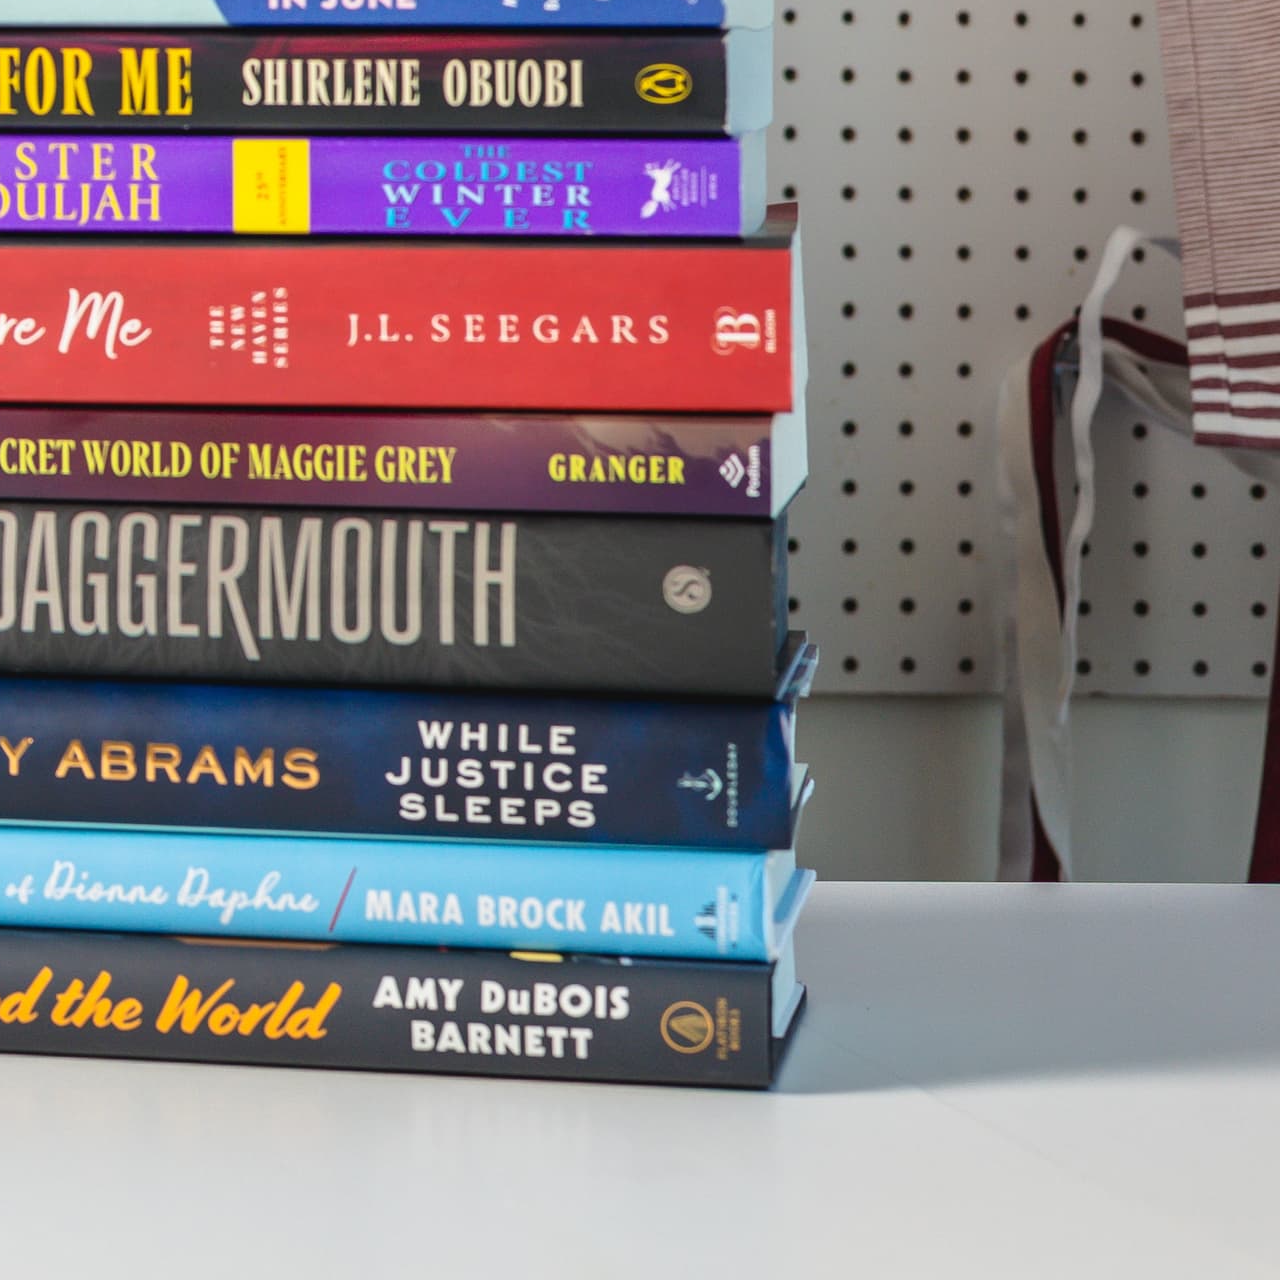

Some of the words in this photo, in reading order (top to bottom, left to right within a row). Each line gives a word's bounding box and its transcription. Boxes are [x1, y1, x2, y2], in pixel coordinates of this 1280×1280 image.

[118, 47, 192, 116] ME
[242, 58, 420, 107] SHIRLENE
[442, 58, 584, 107] OBUOBI
[382, 160, 593, 182] COLDEST
[382, 184, 592, 206] WINTER
[384, 208, 590, 230] EVER
[58, 287, 152, 360] Me
[209, 306, 224, 349] THE
[230, 304, 246, 352] NEW
[346, 314, 414, 346] J.L.
[430, 314, 669, 344] SEEGARS
[81, 440, 192, 478] WORLD
[200, 444, 240, 479] OF
[248, 444, 367, 481] MAGGIE
[375, 446, 457, 484] GREY
[548, 454, 685, 484] GRANGER
[417, 720, 576, 756] WHILE
[56, 740, 320, 789] ABRAMS
[384, 759, 608, 794] JUSTICE
[399, 793, 596, 828] SLEEPS
[5, 881, 34, 903] of
[44, 860, 168, 906] Dionne
[176, 868, 319, 924] Daphne
[364, 888, 464, 925] MARA
[477, 894, 586, 932] BROCK
[600, 900, 676, 936] AKIL
[50, 971, 142, 1031] the
[157, 974, 342, 1040] World
[373, 974, 464, 1012] AMY
[480, 979, 630, 1020] DuBOIS
[410, 1018, 594, 1060] BARNETT
